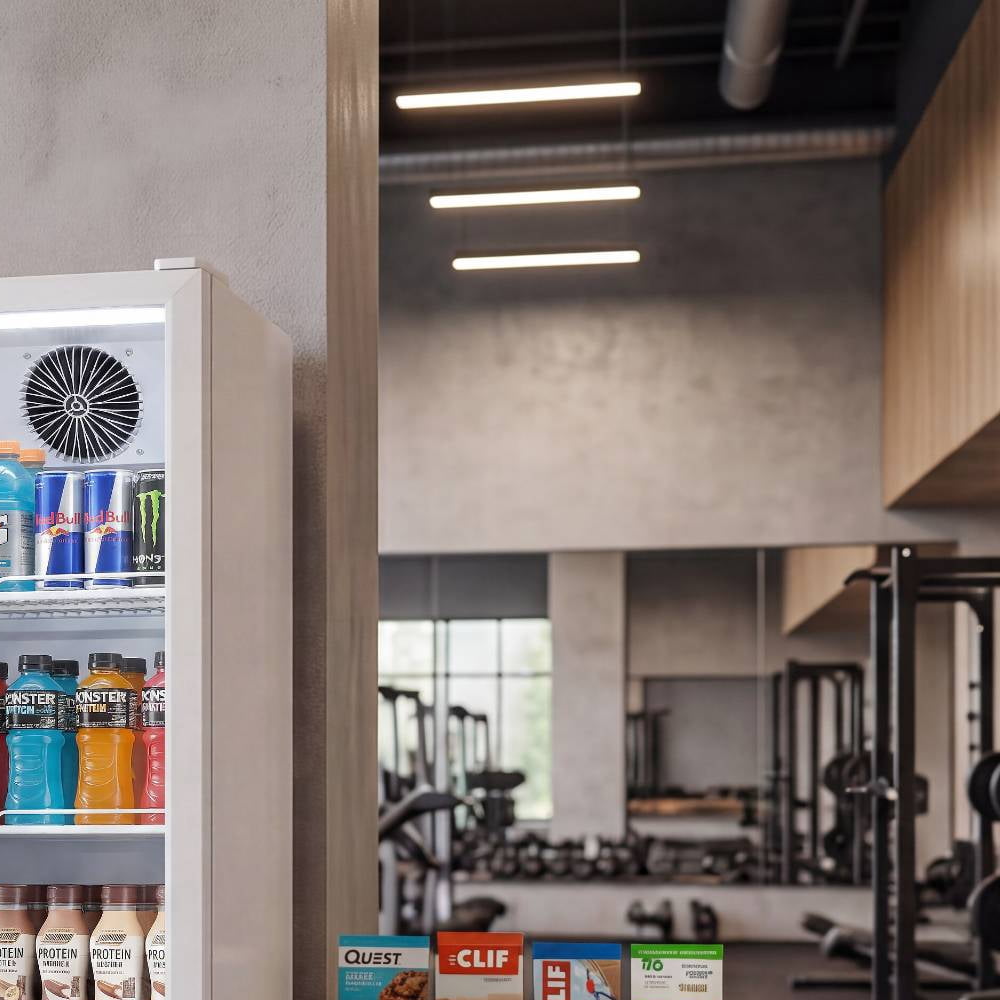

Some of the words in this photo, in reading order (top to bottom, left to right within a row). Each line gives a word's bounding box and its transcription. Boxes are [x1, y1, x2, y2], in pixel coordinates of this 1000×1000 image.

[56, 512, 81, 524] Bull
[38, 948, 78, 960] PROTEIN
[92, 949, 131, 960] PROTEIN
[344, 949, 402, 965] QUEST
[457, 949, 509, 968] CLIF
